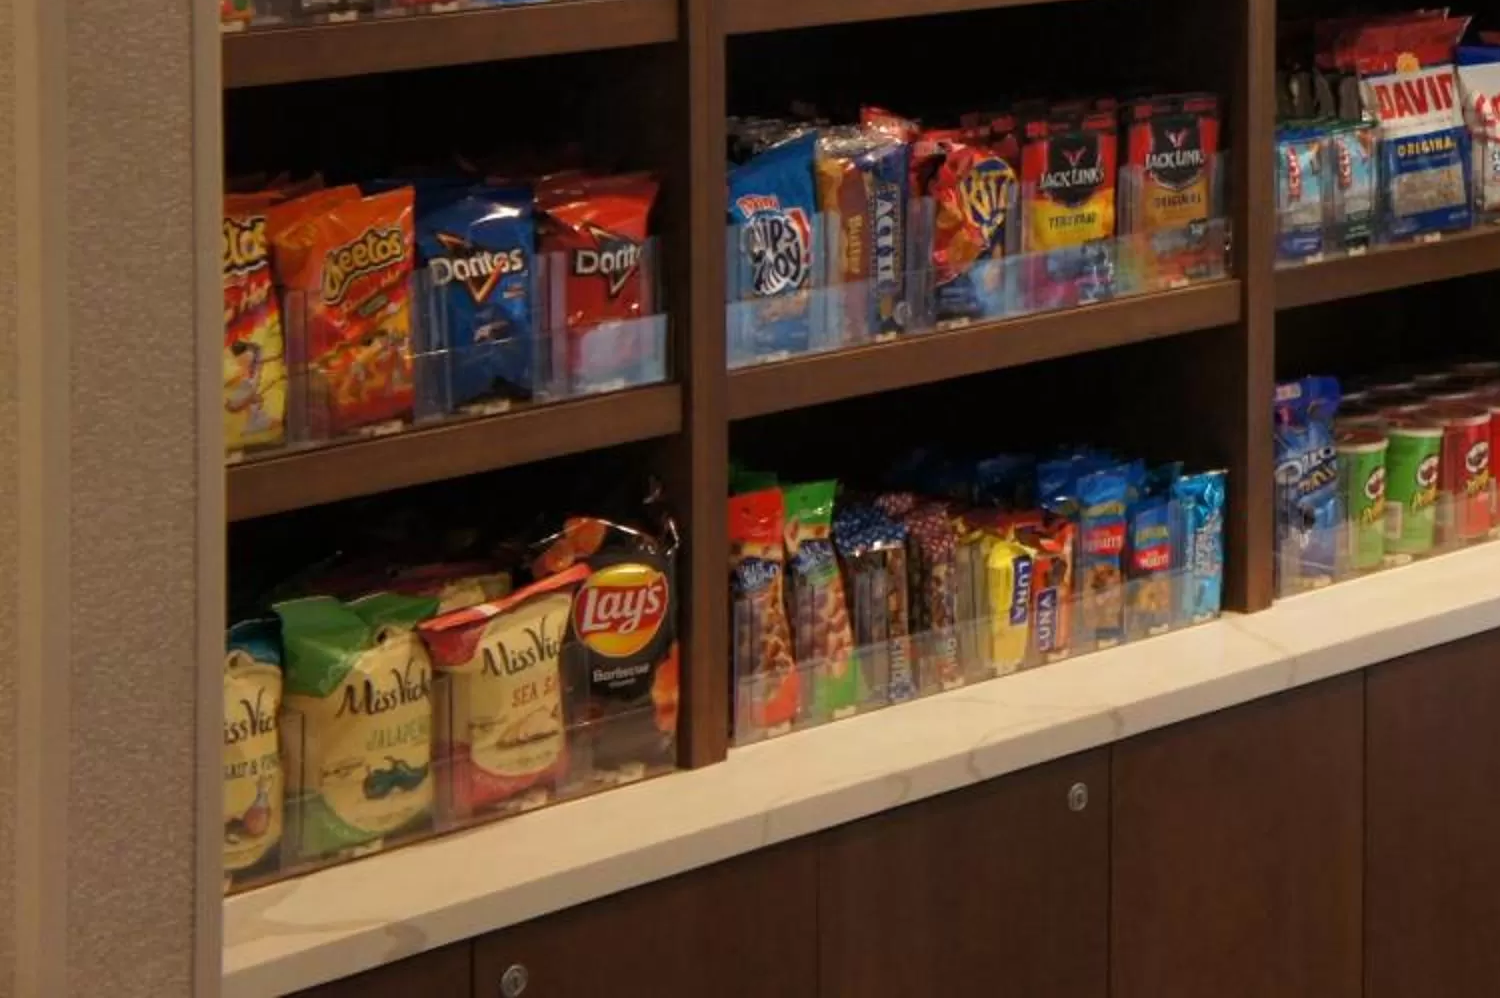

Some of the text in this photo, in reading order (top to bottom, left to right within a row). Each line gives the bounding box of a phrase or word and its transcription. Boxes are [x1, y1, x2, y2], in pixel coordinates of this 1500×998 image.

[1374, 73, 1454, 122] DAVID
[430, 248, 524, 285] Doritos
[581, 580, 663, 635] Lay's
[1012, 560, 1030, 622] LUNA
[1038, 591, 1056, 652] LUNA
